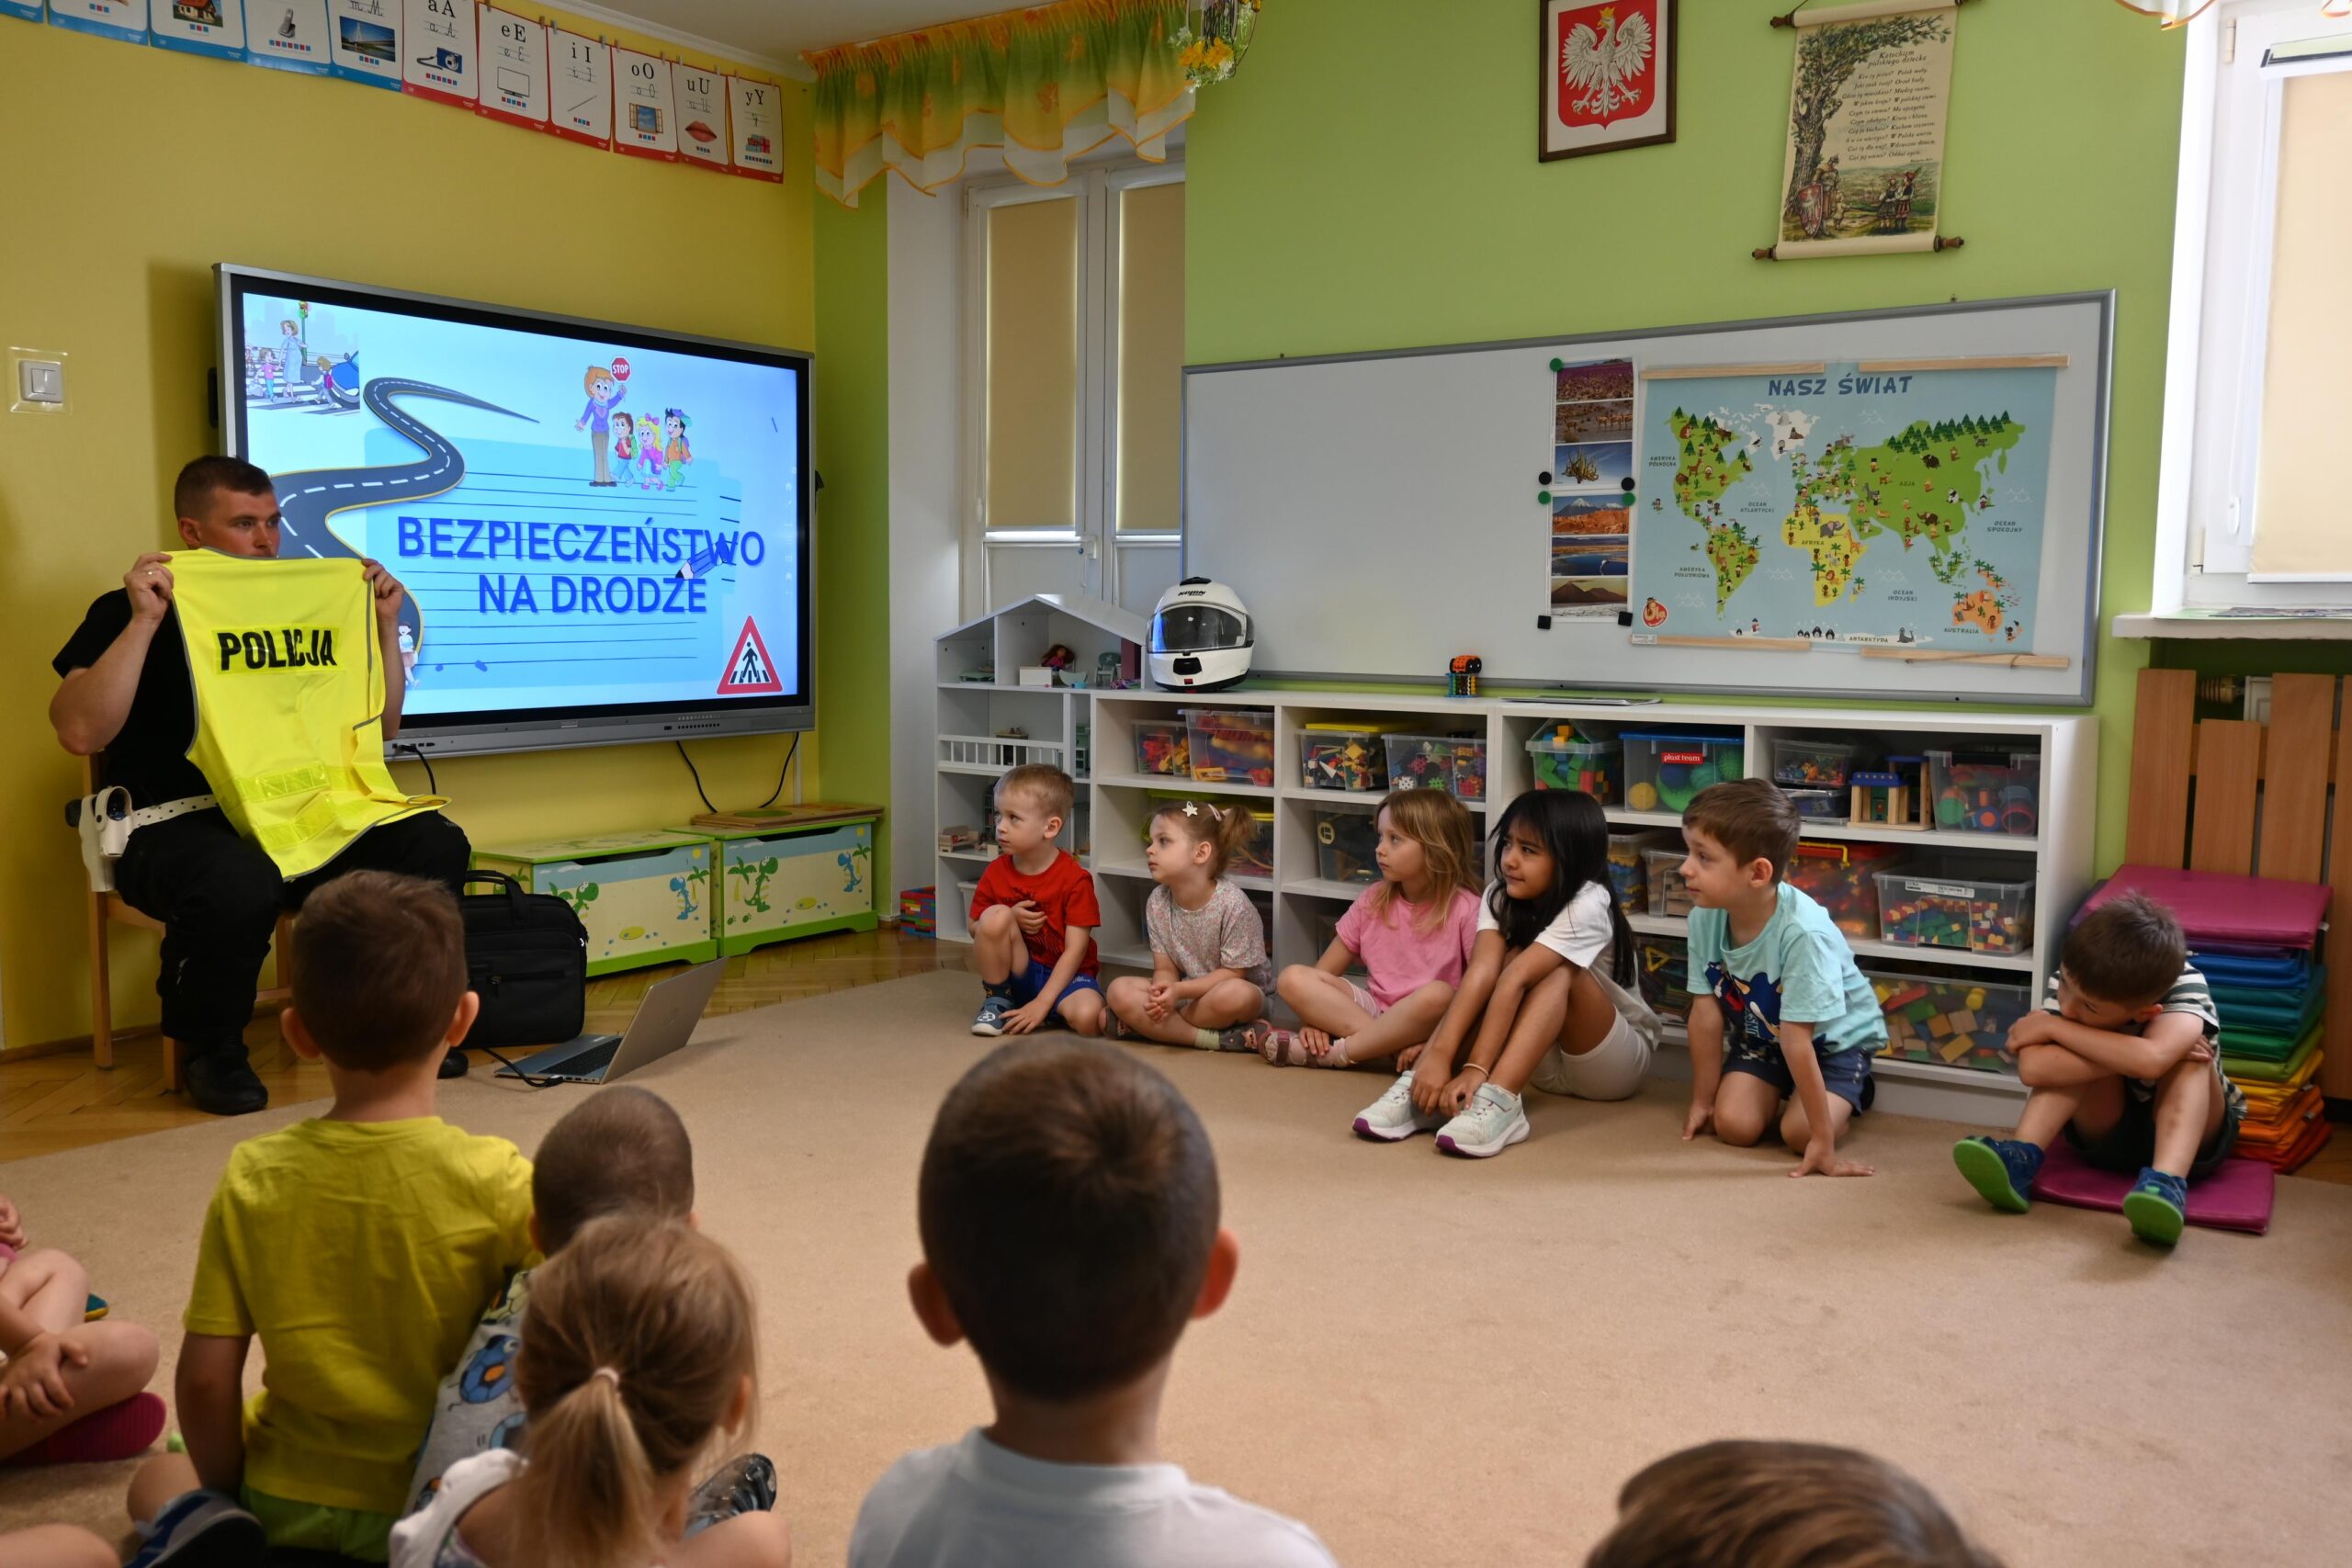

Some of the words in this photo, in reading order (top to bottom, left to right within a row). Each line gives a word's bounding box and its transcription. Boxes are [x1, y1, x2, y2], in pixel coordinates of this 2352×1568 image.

[1867, 58, 1900, 69] polskiego
[1902, 53, 1927, 63] dziecka
[612, 364, 629, 374] STOP
[1768, 378, 1827, 397] NASZ
[1838, 372, 1913, 396] ŚWIAT
[398, 516, 765, 566] BEZPIECZEŃSTWO
[478, 574, 538, 614] NA
[551, 575, 707, 614] DRODZE
[217, 628, 338, 671] POLICJA
[1849, 636, 1889, 644] ANTARKTYDA
[1664, 753, 1681, 762] plast
